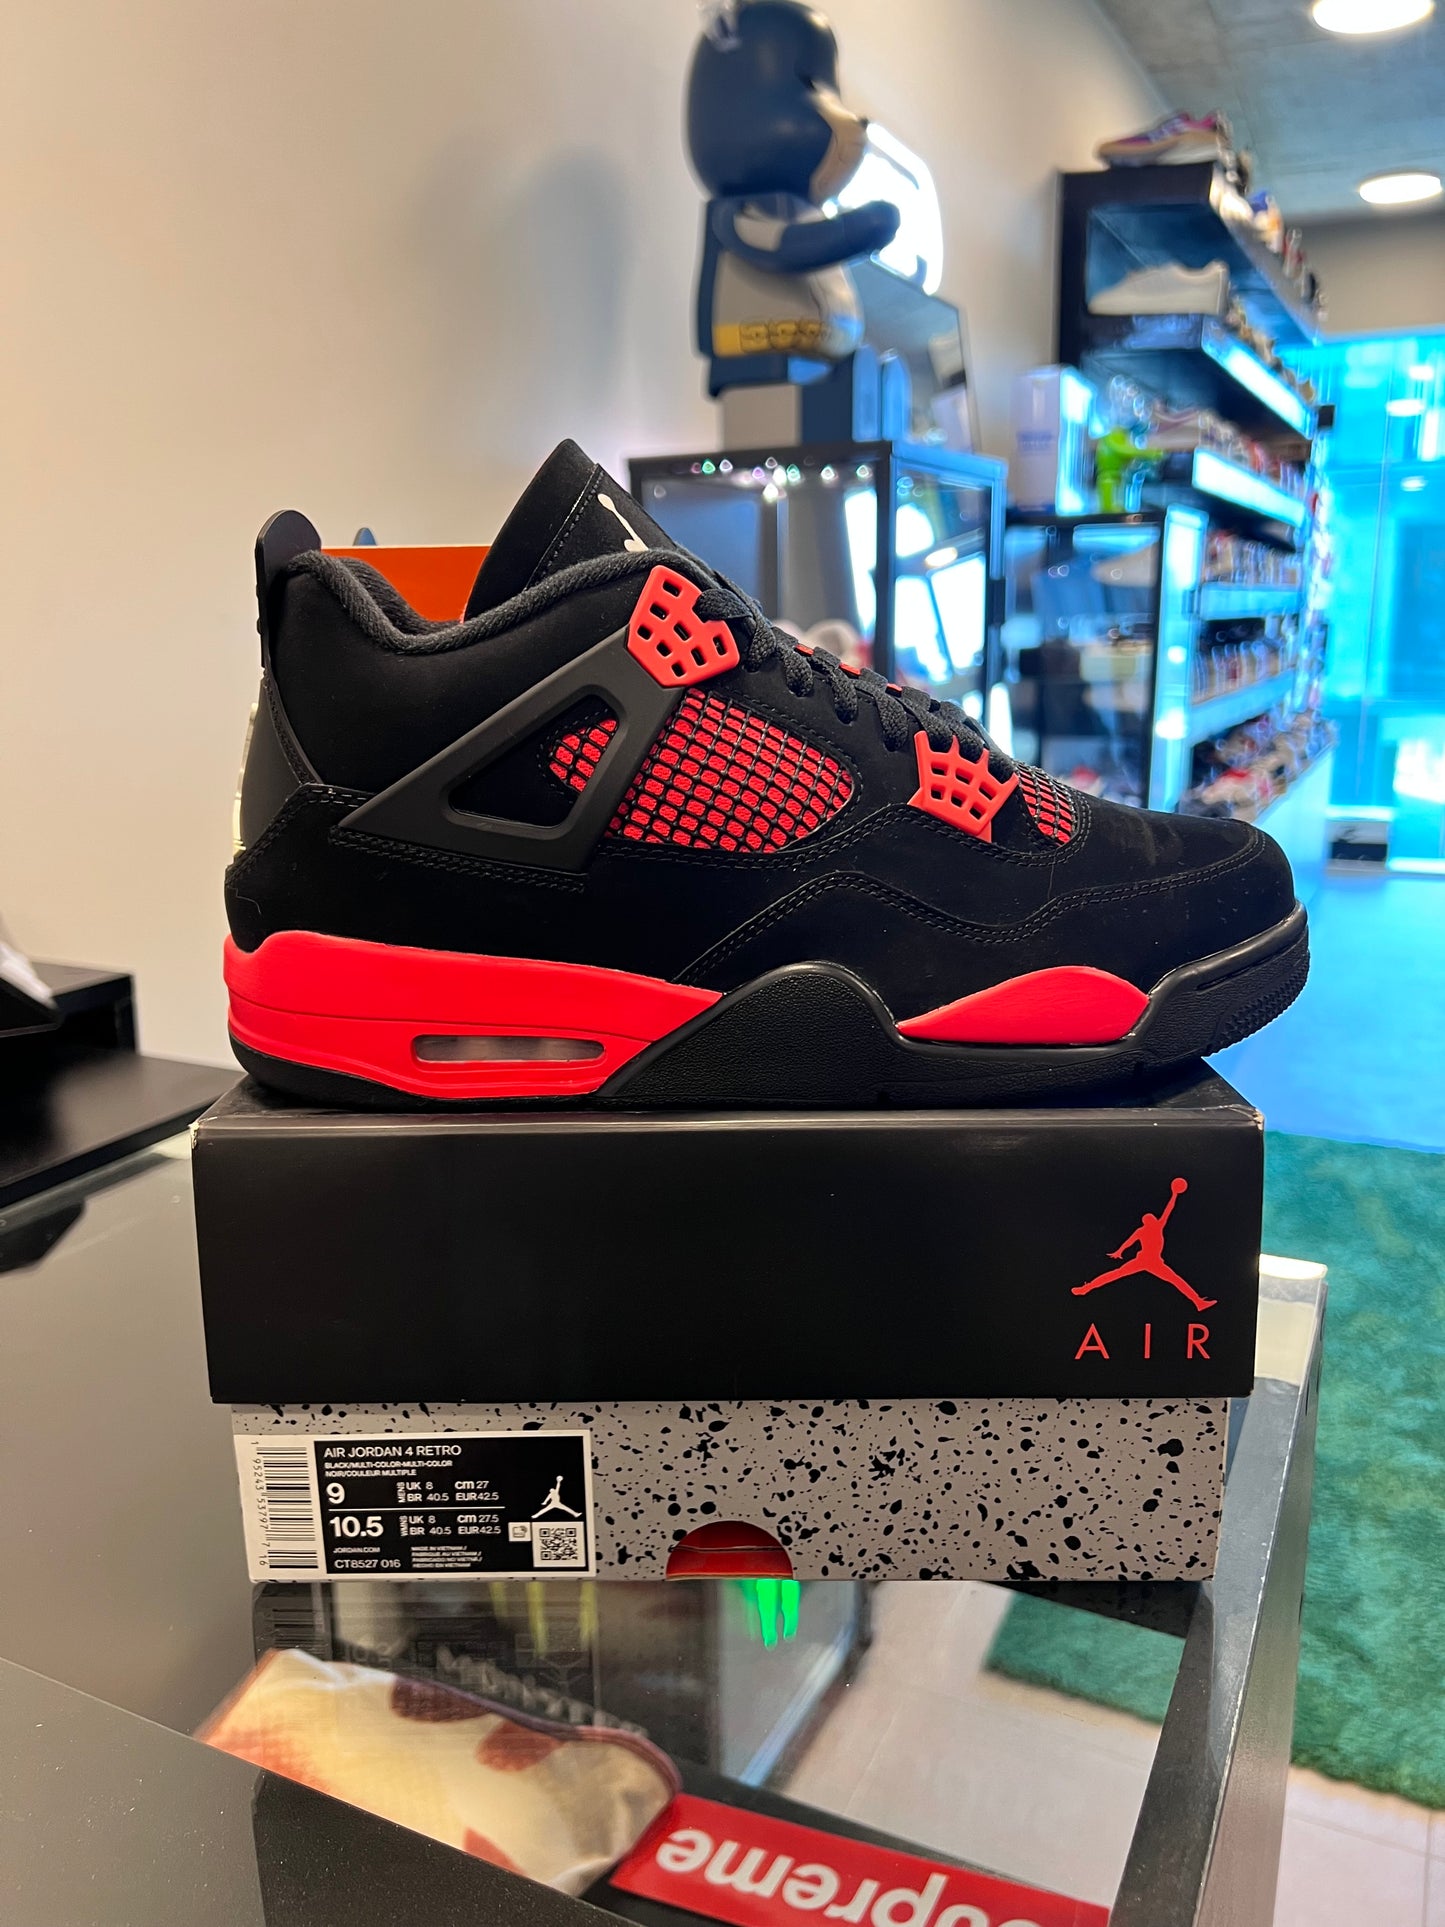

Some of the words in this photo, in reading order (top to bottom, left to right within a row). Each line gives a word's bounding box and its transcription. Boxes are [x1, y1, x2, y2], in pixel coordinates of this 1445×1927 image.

[1074, 1322, 1211, 1360] AIR
[324, 1446, 346, 1458] AIR
[347, 1445, 403, 1458] JORDAN
[404, 1445, 414, 1457] 4
[415, 1444, 462, 1456] RETRO
[252, 1458, 265, 1491] 95243
[381, 1468, 417, 1477] MULTIPLE
[405, 1481, 422, 1491] UK
[425, 1481, 434, 1490] 8
[454, 1480, 475, 1490] cm
[475, 1480, 490, 1489] 27
[326, 1482, 346, 1505] 9
[406, 1493, 423, 1502] BR
[426, 1492, 450, 1501] 40.5
[455, 1492, 477, 1501] EUR
[477, 1491, 500, 1501] 42.5
[256, 1498, 270, 1530] 53797
[408, 1515, 424, 1525] UK
[427, 1515, 437, 1524] 8
[457, 1514, 477, 1523] cm
[478, 1514, 500, 1523] 27.5
[329, 1515, 384, 1537] 10.5
[409, 1526, 425, 1536] BR
[428, 1526, 452, 1535] 40.5
[457, 1526, 479, 1535] EUR
[479, 1525, 502, 1535] 42.5
[258, 1554, 268, 1567] 16
[334, 1559, 379, 1569] CT8527
[380, 1559, 402, 1568] 016
[655, 1827, 1046, 1927] upreme
